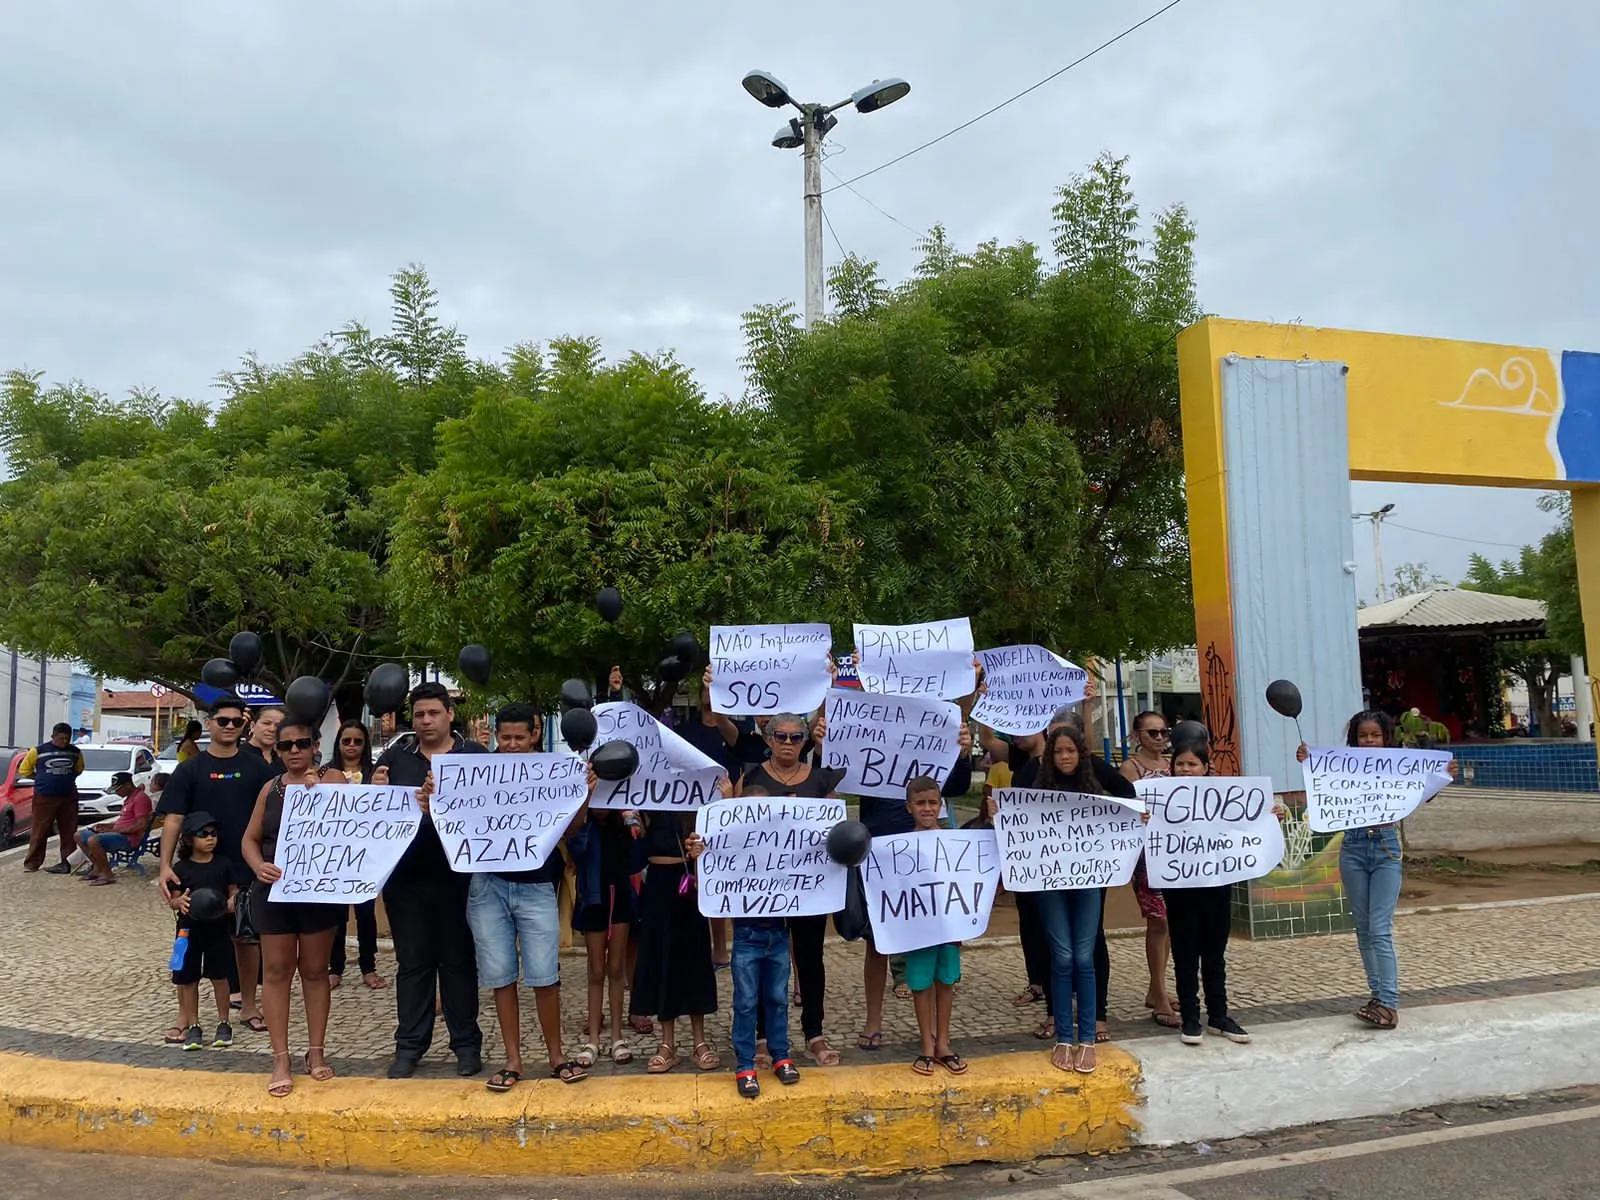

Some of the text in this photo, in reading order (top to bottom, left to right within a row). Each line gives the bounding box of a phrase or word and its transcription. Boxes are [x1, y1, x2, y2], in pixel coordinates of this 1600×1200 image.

[716, 628, 752, 655] NÃO
[859, 625, 950, 662] PAREM
[886, 656, 900, 681] A
[983, 647, 1035, 674] ANGELA
[720, 681, 781, 709] SOS
[1028, 688, 1035, 699] A
[598, 708, 631, 735] SE
[829, 697, 951, 728] ANGELA FOI
[900, 733, 950, 754] FATAL
[828, 751, 851, 767] DA
[1309, 750, 1359, 775] VÍCIO
[1363, 757, 1393, 775] EM
[438, 762, 544, 795] FAMILIAS
[288, 789, 411, 822] POR ANGELA
[433, 795, 487, 815] SENDO
[999, 790, 1068, 809] MINHA
[1140, 785, 1265, 824] #GLOBO
[435, 819, 466, 835] POR
[475, 812, 532, 835] JOGOS
[705, 803, 771, 833] FORAM
[1041, 810, 1065, 825] ME
[1071, 804, 1121, 821] PEDIU
[743, 830, 779, 849] EM
[1067, 824, 1105, 840] MAS
[1241, 836, 1262, 848] AO
[866, 837, 995, 882] A BLAZE
[1040, 837, 1105, 859] AUDIOS
[283, 842, 367, 880] PAREM
[703, 852, 737, 875] QUE
[745, 854, 757, 872] A
[1009, 858, 1121, 885] AJUDA OUTRAS
[1161, 854, 1257, 882] SUICIDIO
[282, 878, 340, 895] ESSES
[720, 892, 800, 914] A VIDA
[880, 881, 984, 925] MATA!
